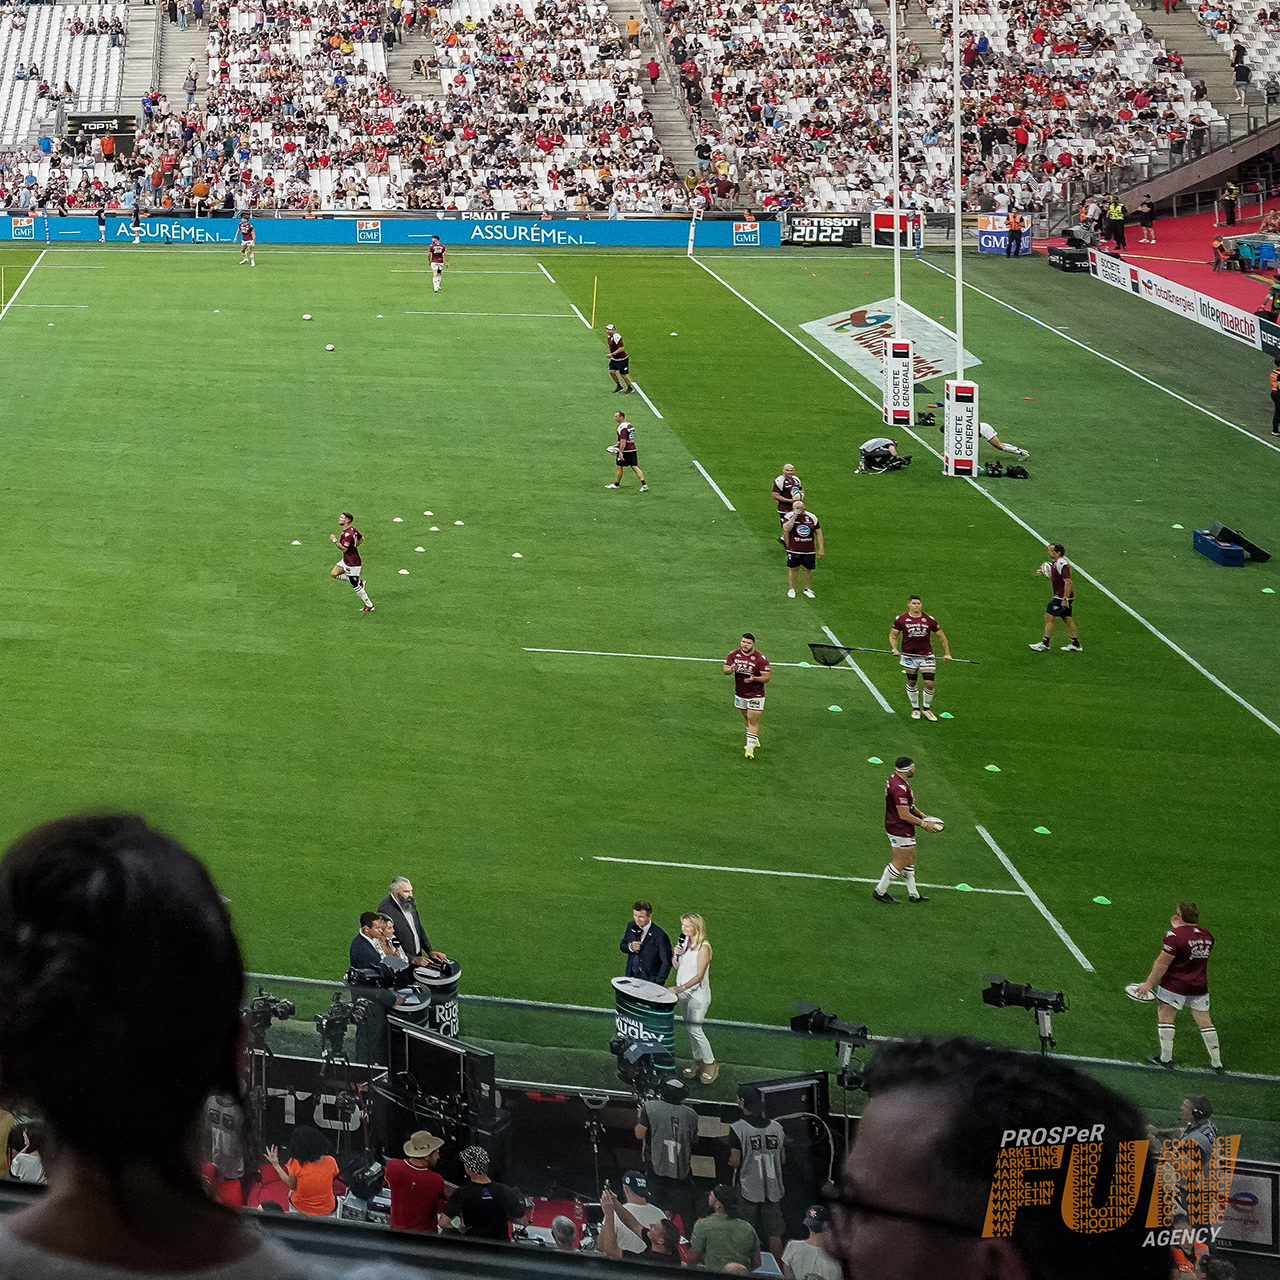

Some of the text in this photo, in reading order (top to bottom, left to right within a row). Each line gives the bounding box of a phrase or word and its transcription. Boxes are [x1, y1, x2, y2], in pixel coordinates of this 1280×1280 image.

[82, 119, 117, 130] TOP14
[813, 218, 860, 226] TISSOT
[14, 228, 32, 237] GMF
[359, 231, 378, 240] GMF
[736, 234, 757, 243] GMF
[1101, 257, 1120, 274] SOCIETE
[1154, 283, 1195, 313] TotalEnergies
[1199, 297, 1255, 339] Intermarché
[902, 361, 910, 407] GENERALE
[955, 415, 963, 456] SOCIETE
[965, 406, 974, 456] GENERALE
[436, 1004, 458, 1023] Rug
